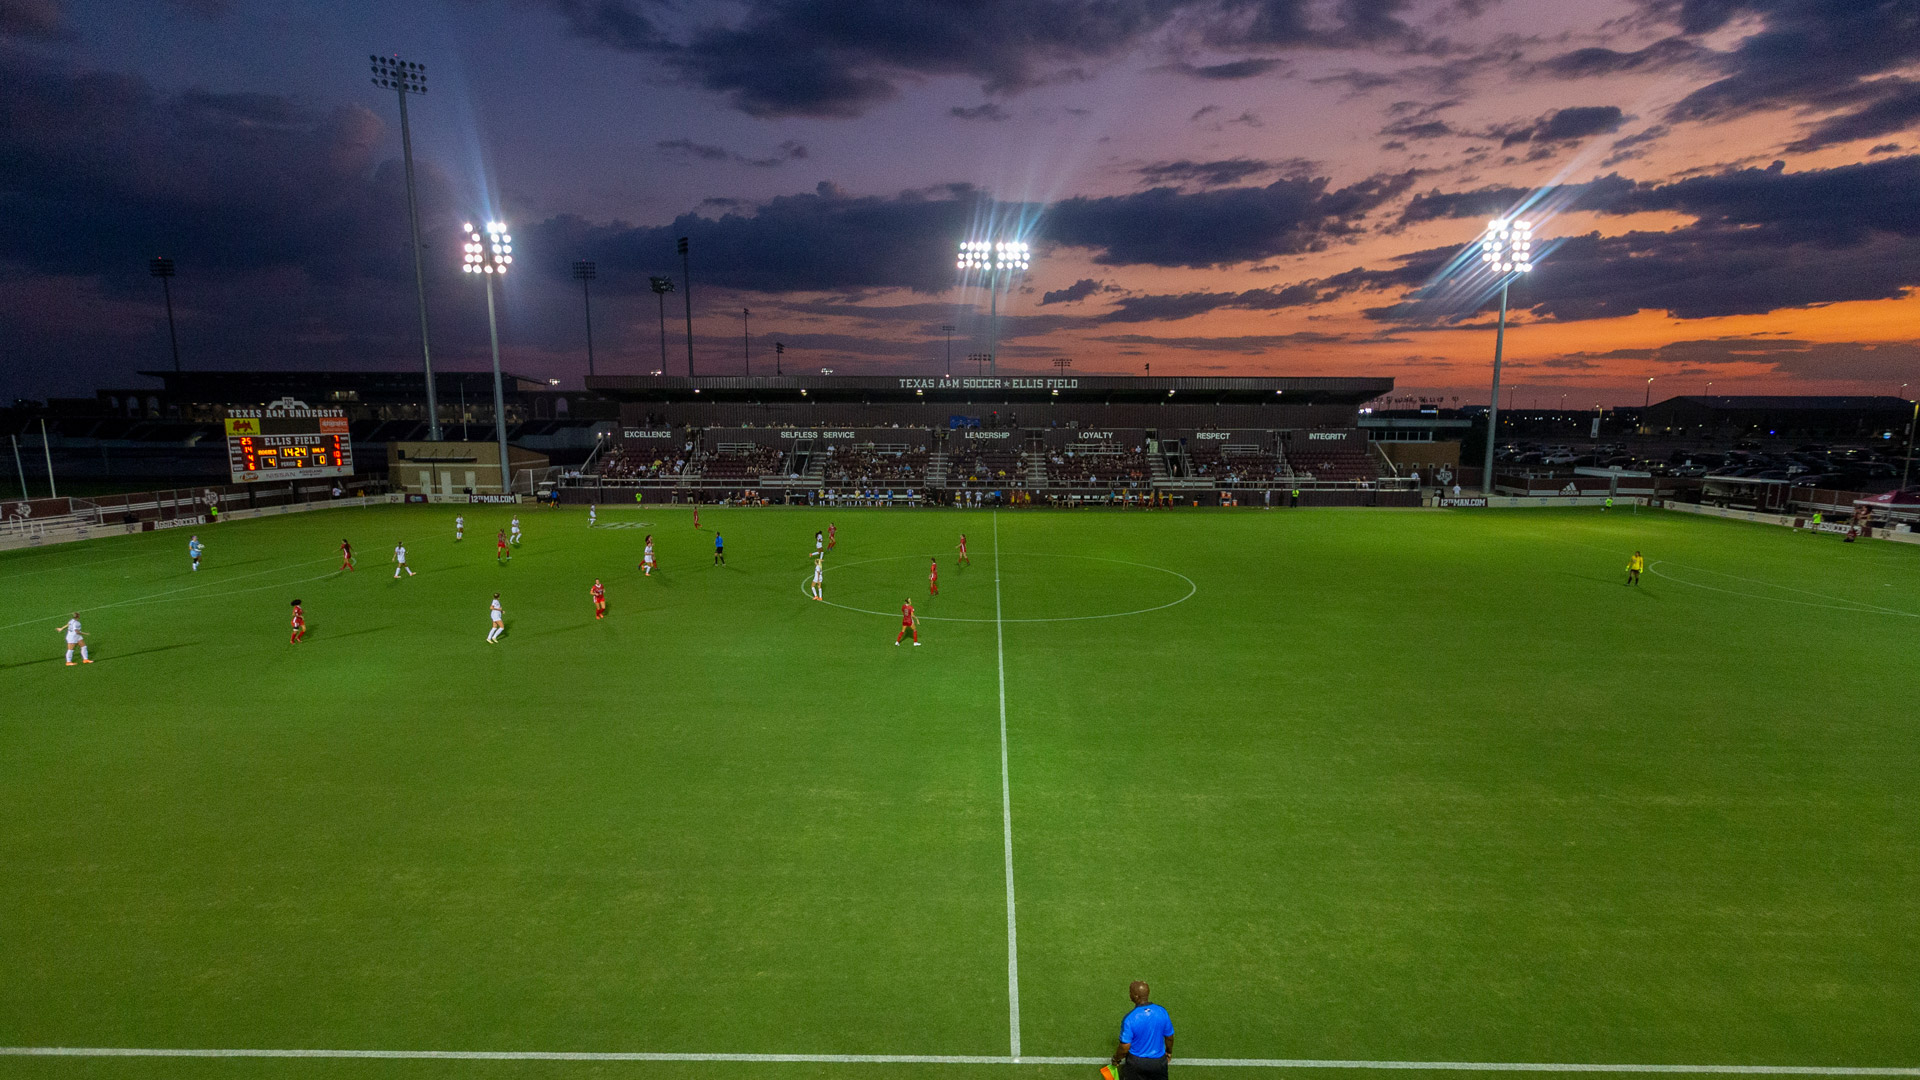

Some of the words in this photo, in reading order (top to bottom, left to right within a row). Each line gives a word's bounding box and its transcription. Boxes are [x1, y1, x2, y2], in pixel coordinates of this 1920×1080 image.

[899, 379, 935, 388] TEXAS
[939, 379, 959, 388] A&M
[963, 379, 1001, 388] SOCCER
[1013, 379, 1043, 388] ELLIS
[1047, 379, 1077, 388] FIELD
[228, 409, 261, 418] TEXAS
[266, 410, 285, 418] A&M
[290, 409, 344, 417] UNIVERSITY
[241, 437, 252, 445] 25
[264, 437, 292, 446] ELLIS
[294, 436, 321, 445] FIELD
[333, 442, 340, 450] 4
[247, 454, 254, 462] 4
[333, 450, 341, 458] 10
[268, 458, 276, 466] 4
[297, 459, 303, 468] 2
[319, 455, 326, 465] 0
